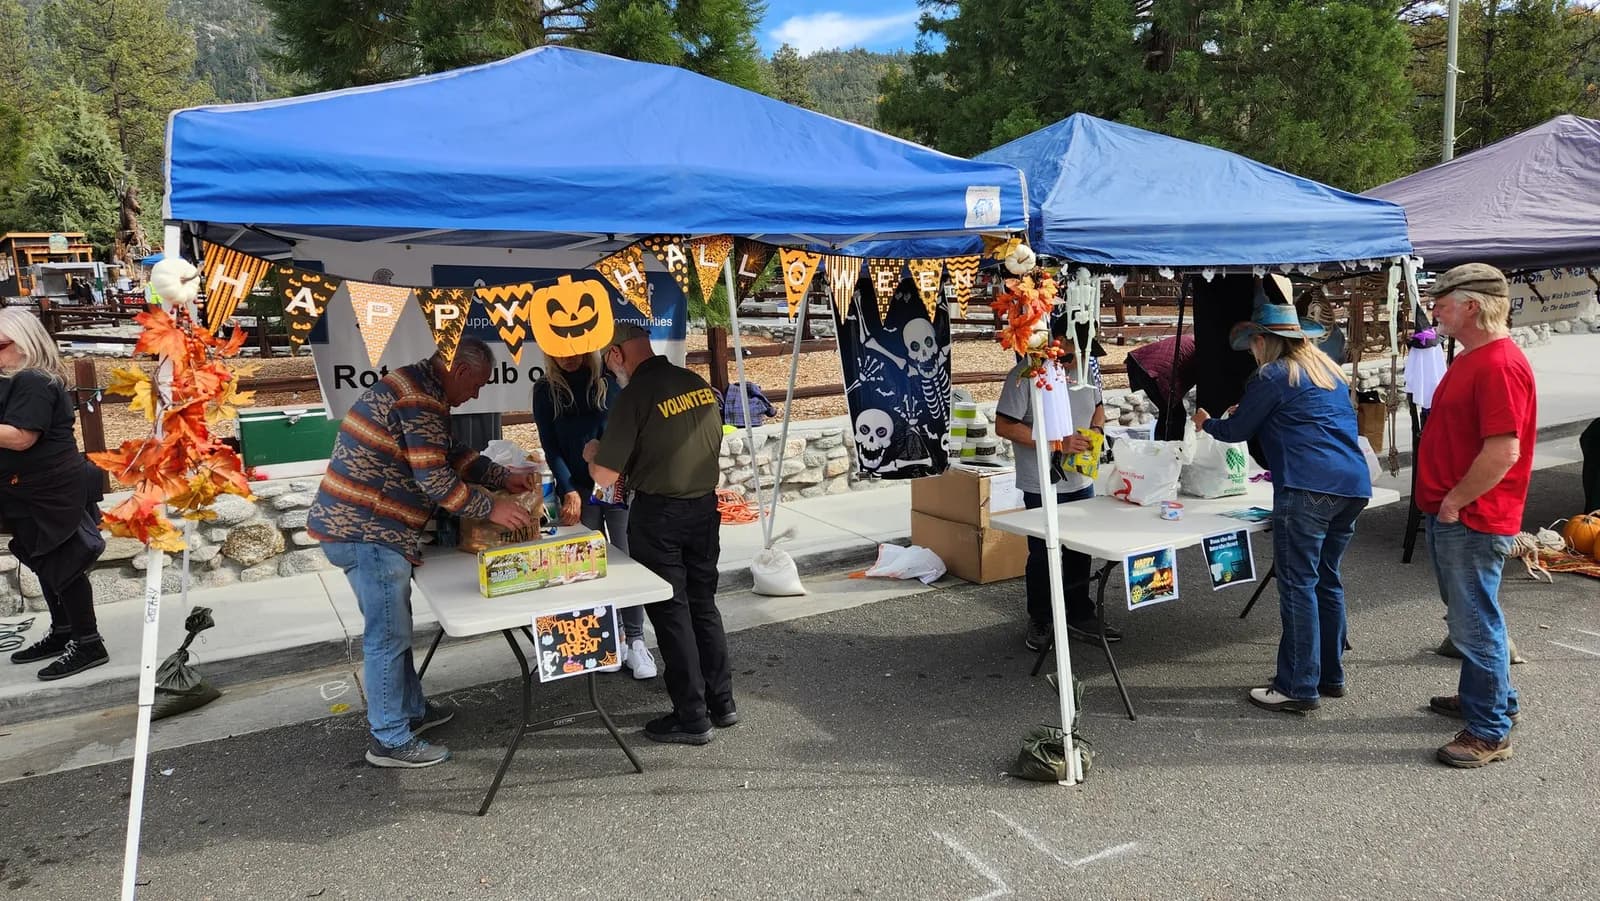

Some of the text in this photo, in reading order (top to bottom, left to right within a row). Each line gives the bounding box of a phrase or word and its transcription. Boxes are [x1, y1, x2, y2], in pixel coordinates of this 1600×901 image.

[334, 364, 390, 389] Rot
[486, 361, 519, 385] ub
[657, 387, 716, 418] VOLUNTEE
[554, 615, 600, 635] TRICK
[566, 628, 591, 644] OR
[557, 638, 601, 656] TREAT
